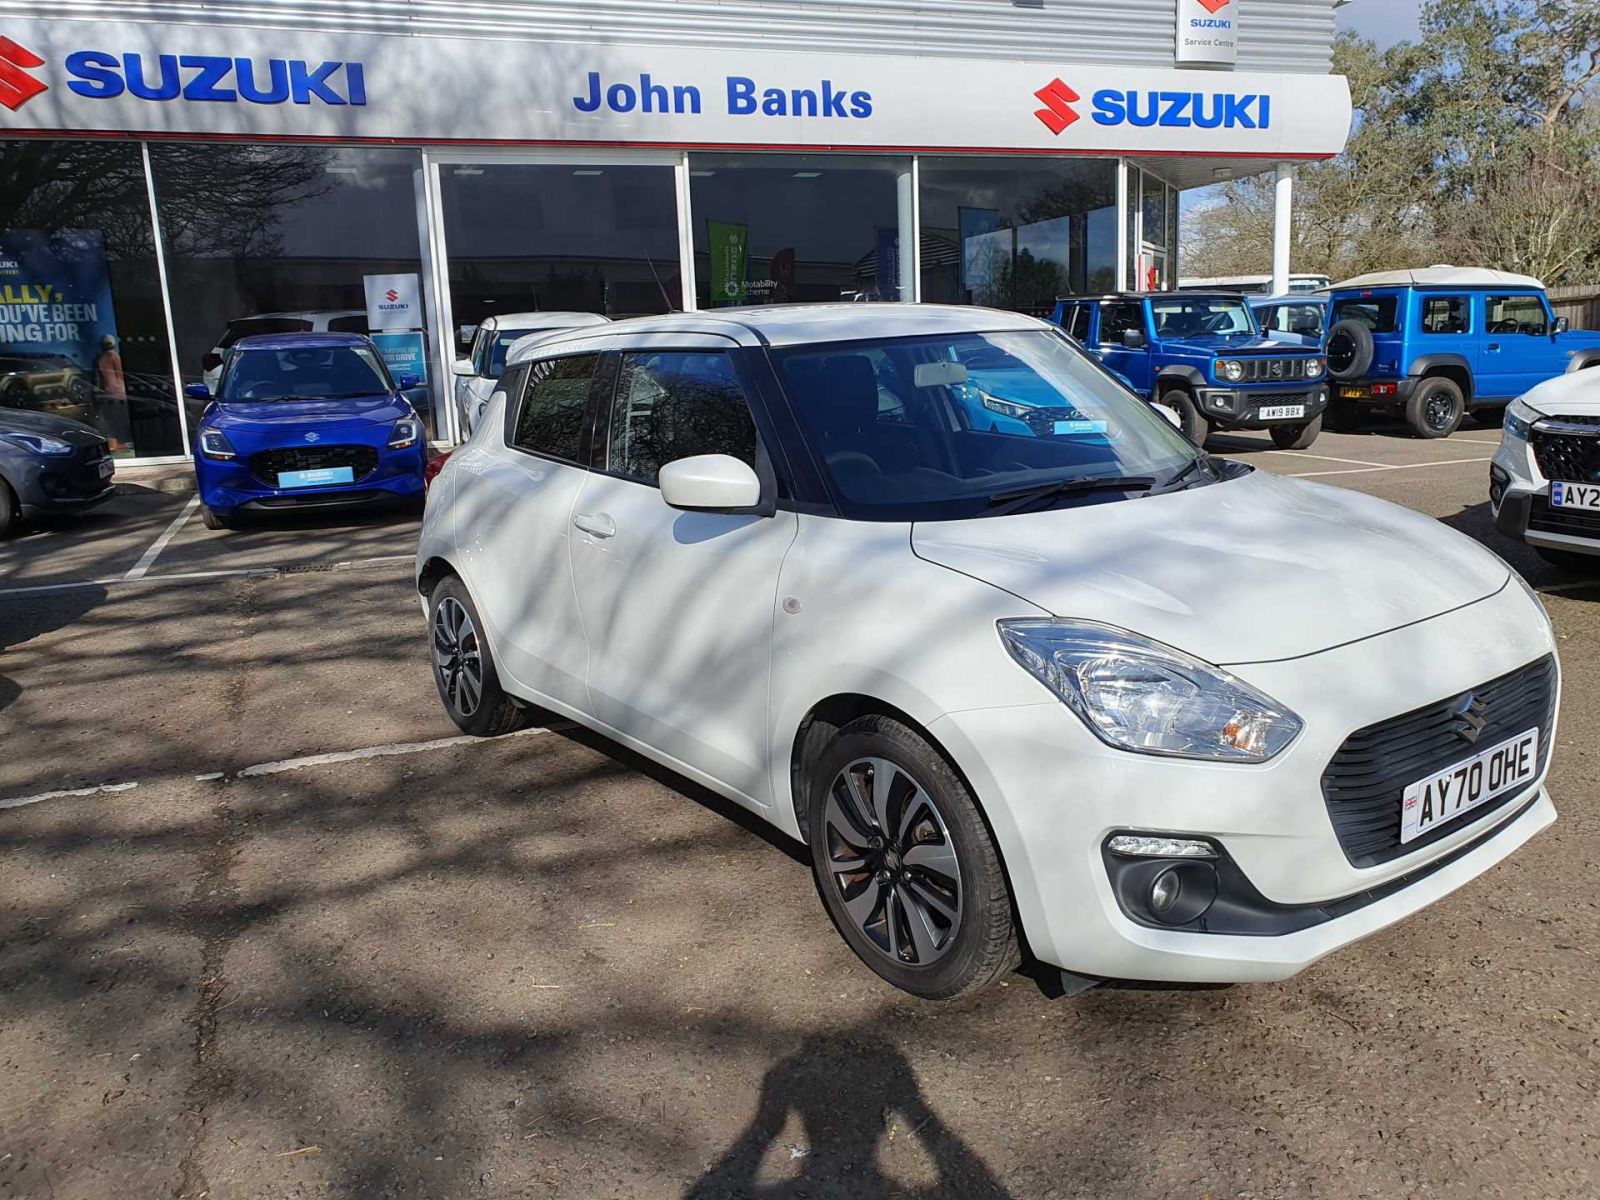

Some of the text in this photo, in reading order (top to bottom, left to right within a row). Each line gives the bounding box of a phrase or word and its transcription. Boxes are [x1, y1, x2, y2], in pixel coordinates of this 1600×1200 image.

[1190, 19, 1231, 28] SUZUKI
[1184, 38, 1234, 48] Service Centre
[65, 50, 367, 106] SUZUKI
[573, 71, 873, 119] John Banks
[1091, 89, 1270, 129] SUZUKI
[741, 280, 778, 288] Motability
[52, 303, 98, 322] BEEN
[45, 323, 81, 342] FOR
[1419, 737, 1532, 827] AY70 OHE
